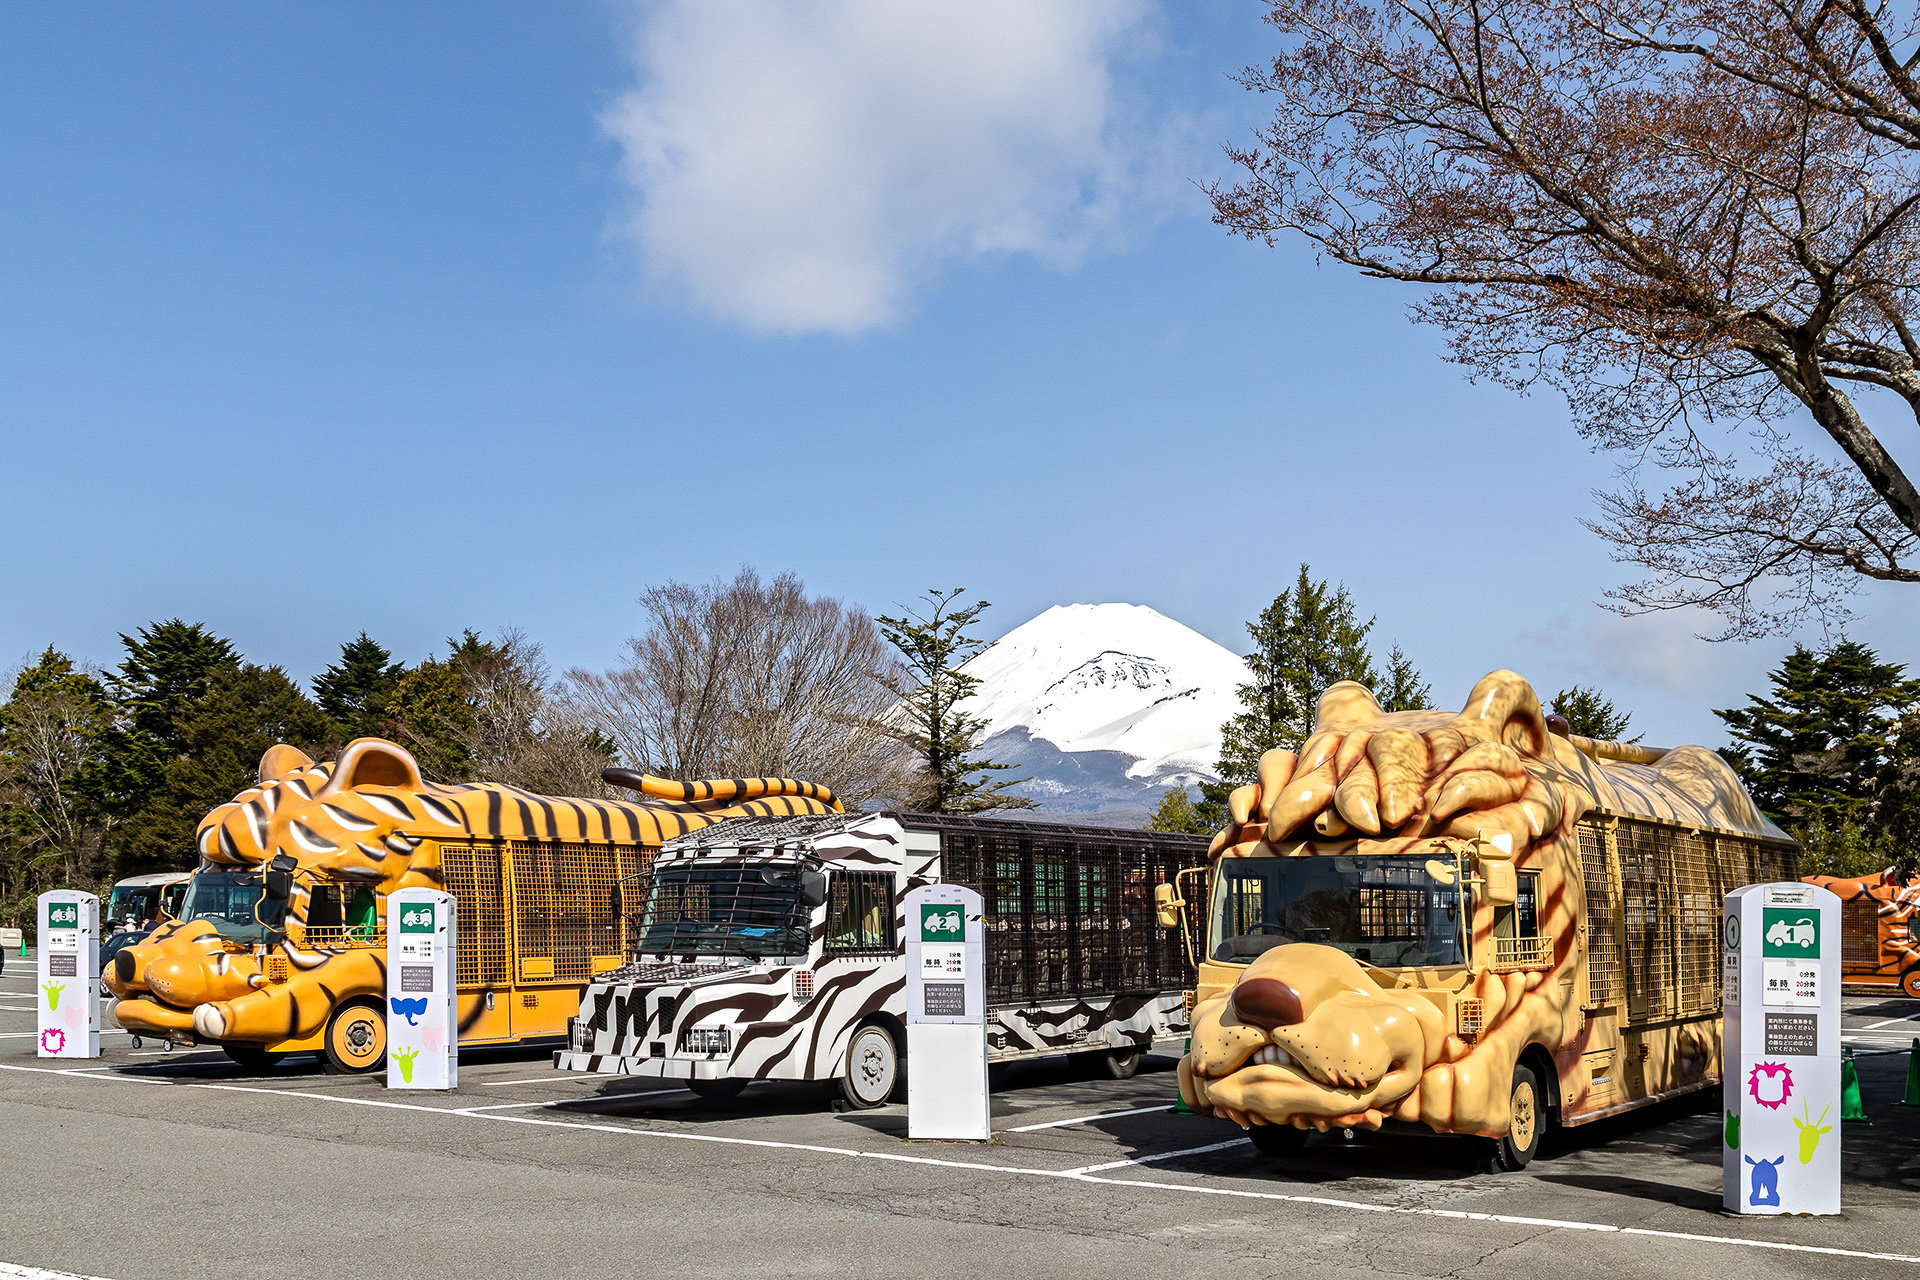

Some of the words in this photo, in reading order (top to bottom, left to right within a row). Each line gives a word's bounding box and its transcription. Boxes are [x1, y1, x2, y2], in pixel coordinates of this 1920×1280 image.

[61, 912, 67, 920] 5
[415, 914, 421, 923] 3
[939, 917, 947, 928] 2
[1731, 924, 1735, 939] 1
[1786, 927, 1794, 941] 1
